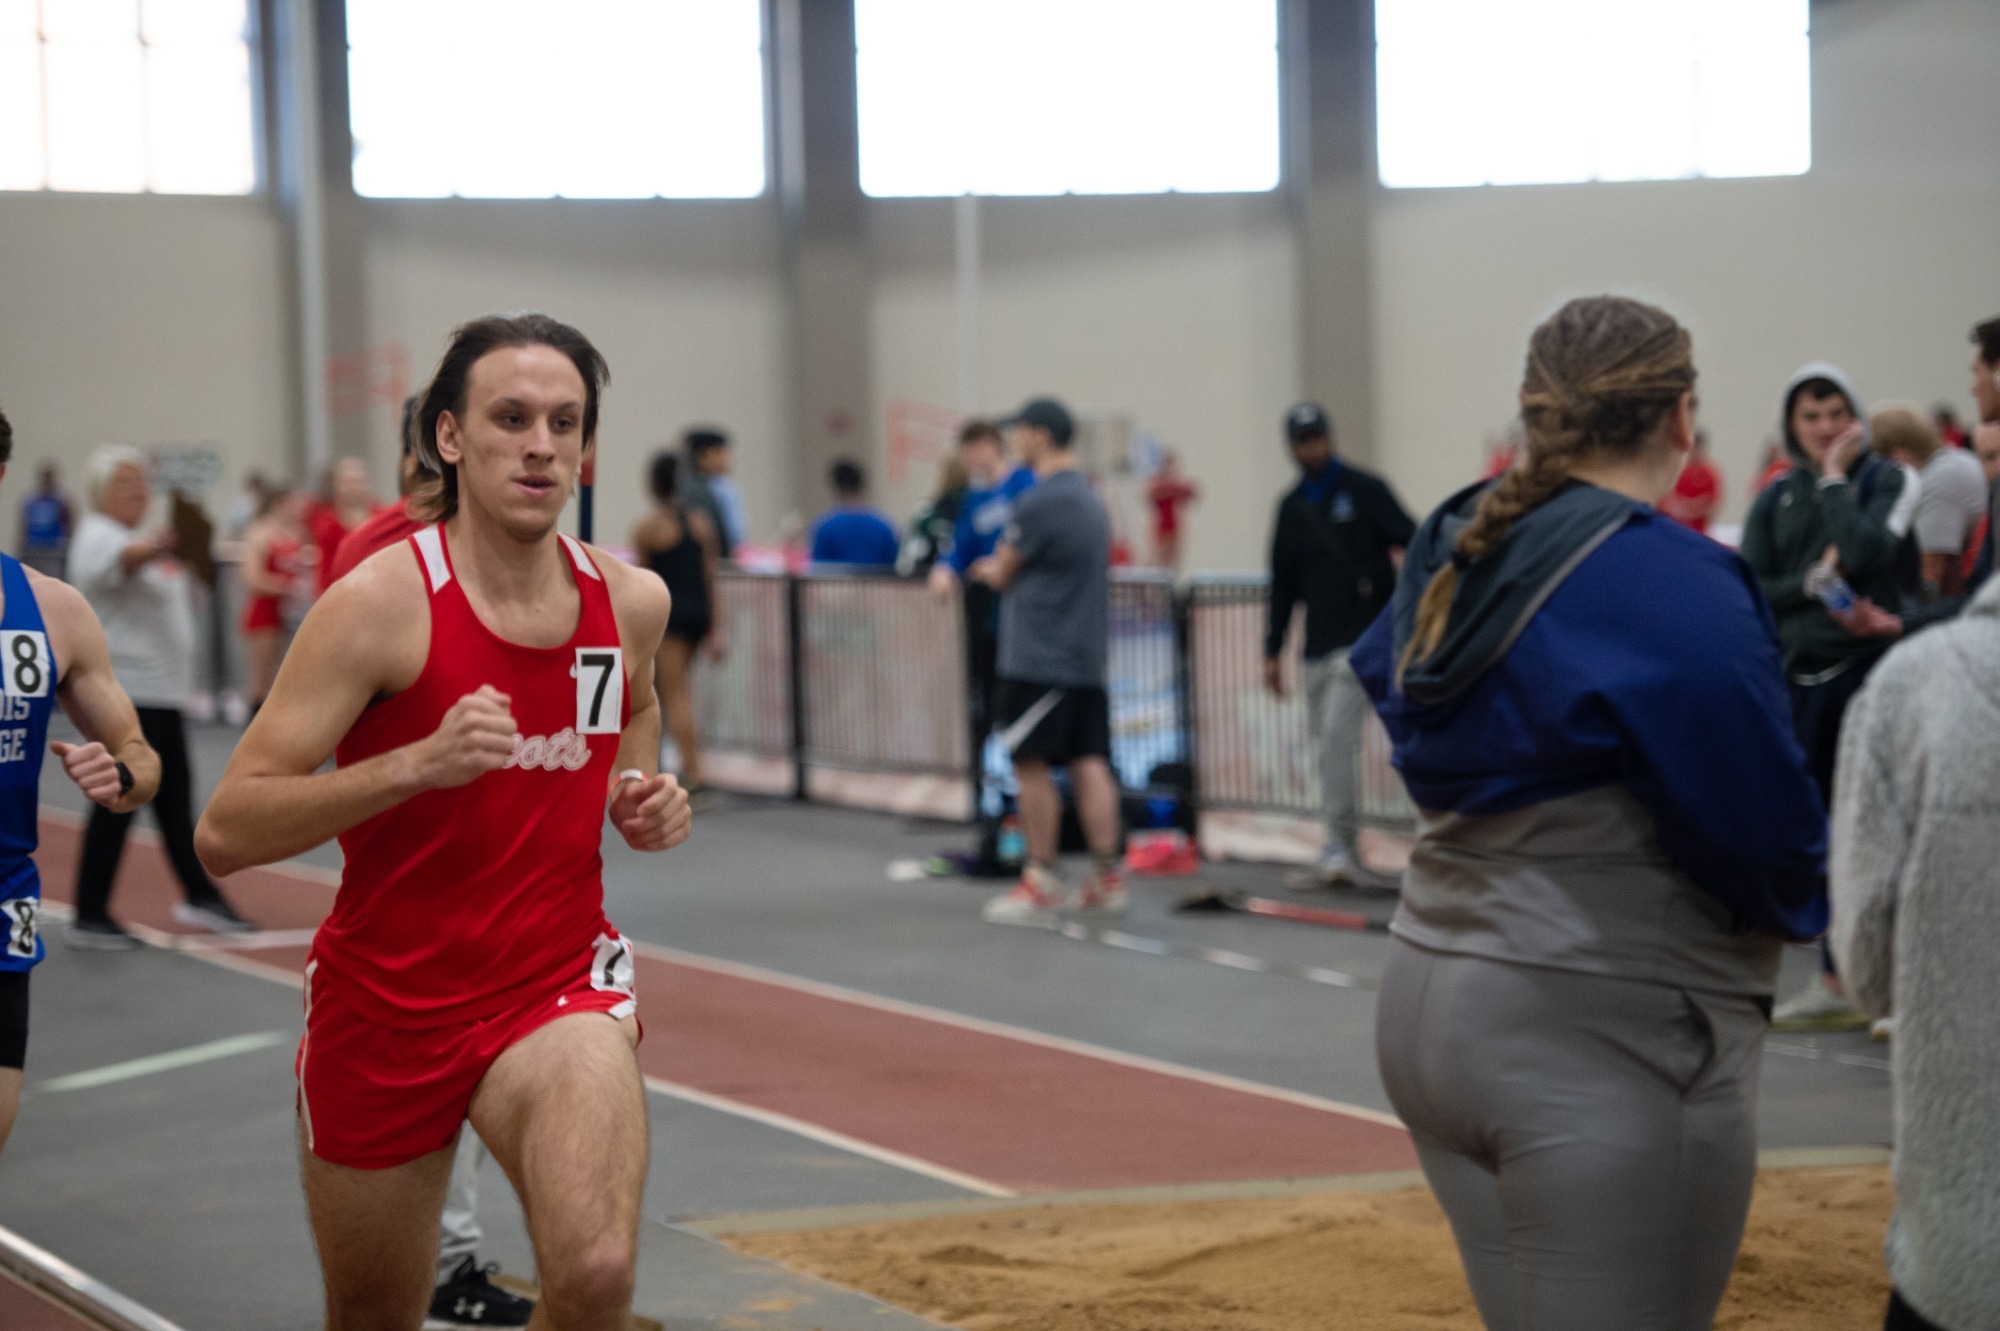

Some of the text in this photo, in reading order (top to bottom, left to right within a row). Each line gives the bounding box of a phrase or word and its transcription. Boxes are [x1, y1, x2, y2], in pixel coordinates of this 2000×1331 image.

[11, 634, 42, 694] 8
[580, 653, 616, 728] 7
[13, 901, 34, 955] 8
[603, 944, 626, 987] 7
